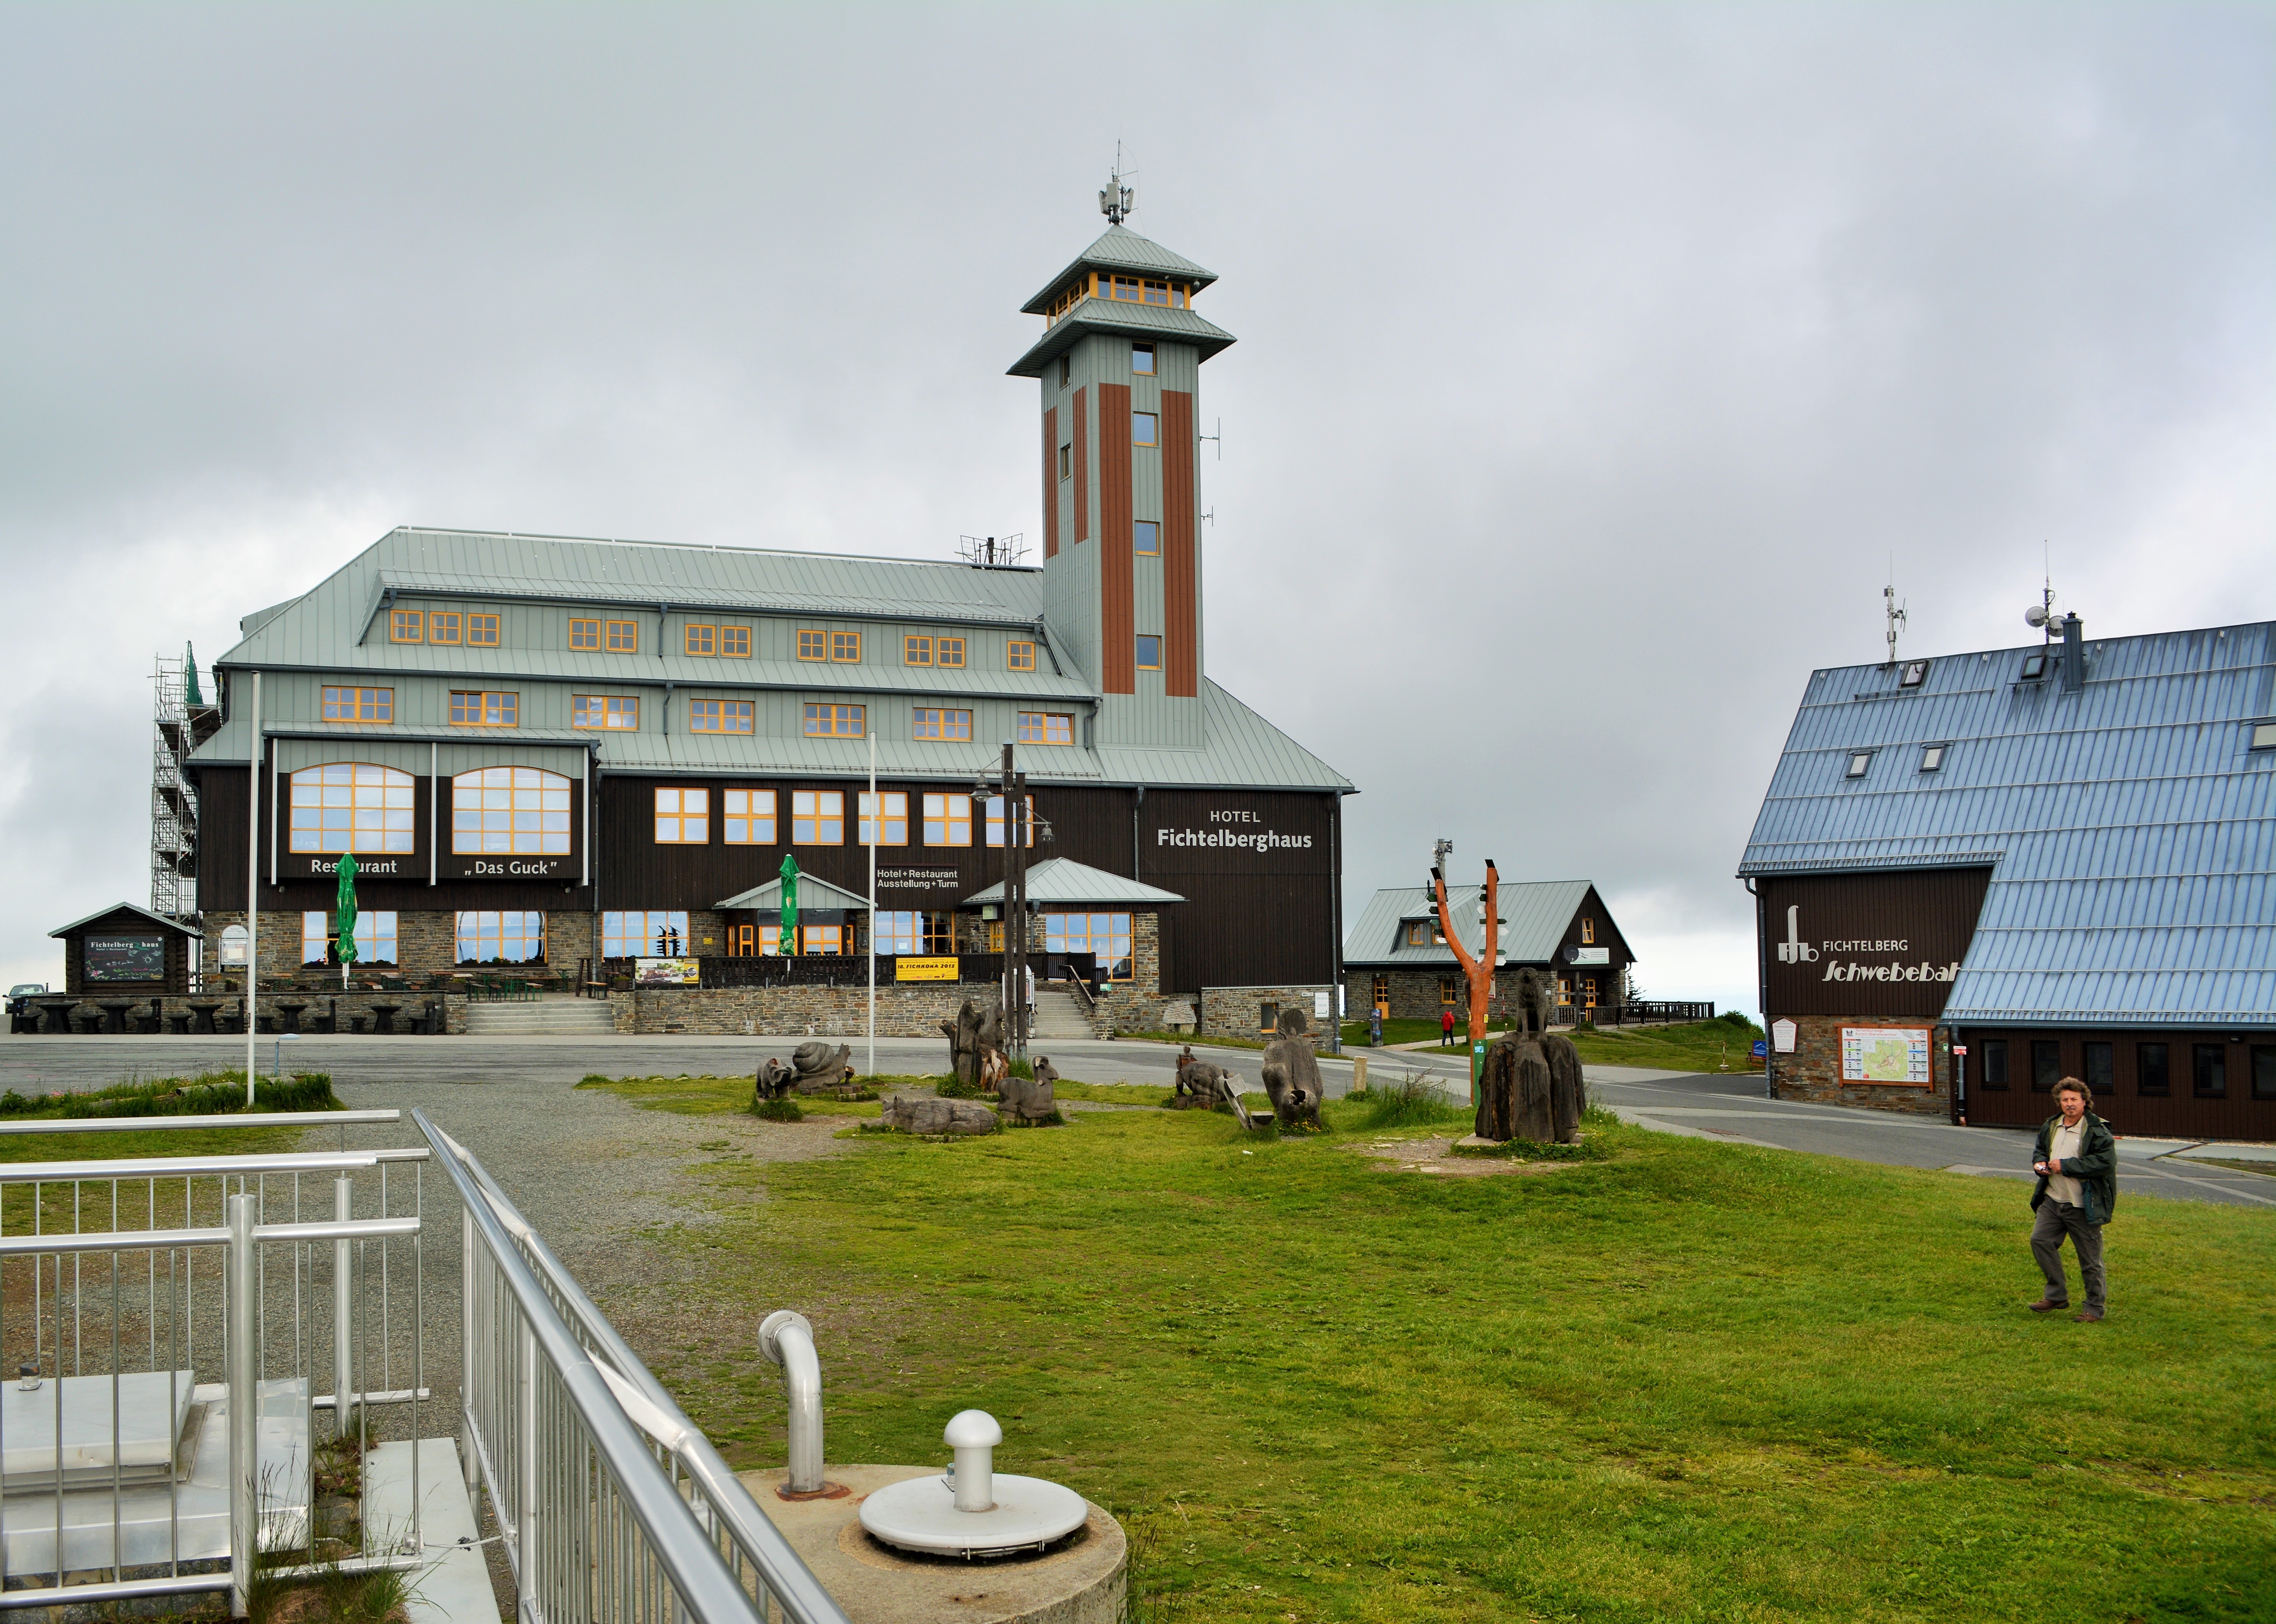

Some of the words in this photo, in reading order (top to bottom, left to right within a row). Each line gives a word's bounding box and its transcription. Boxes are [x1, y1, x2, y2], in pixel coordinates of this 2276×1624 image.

[1211, 811, 1261, 822] HOTEL
[1158, 828, 1312, 852] Fichtelberghaus
[312, 860, 397, 873] Resurant
[909, 870, 957, 878] Restaurant
[877, 880, 930, 889] Ausstellung
[1823, 940, 1908, 951] FICHTELBERG
